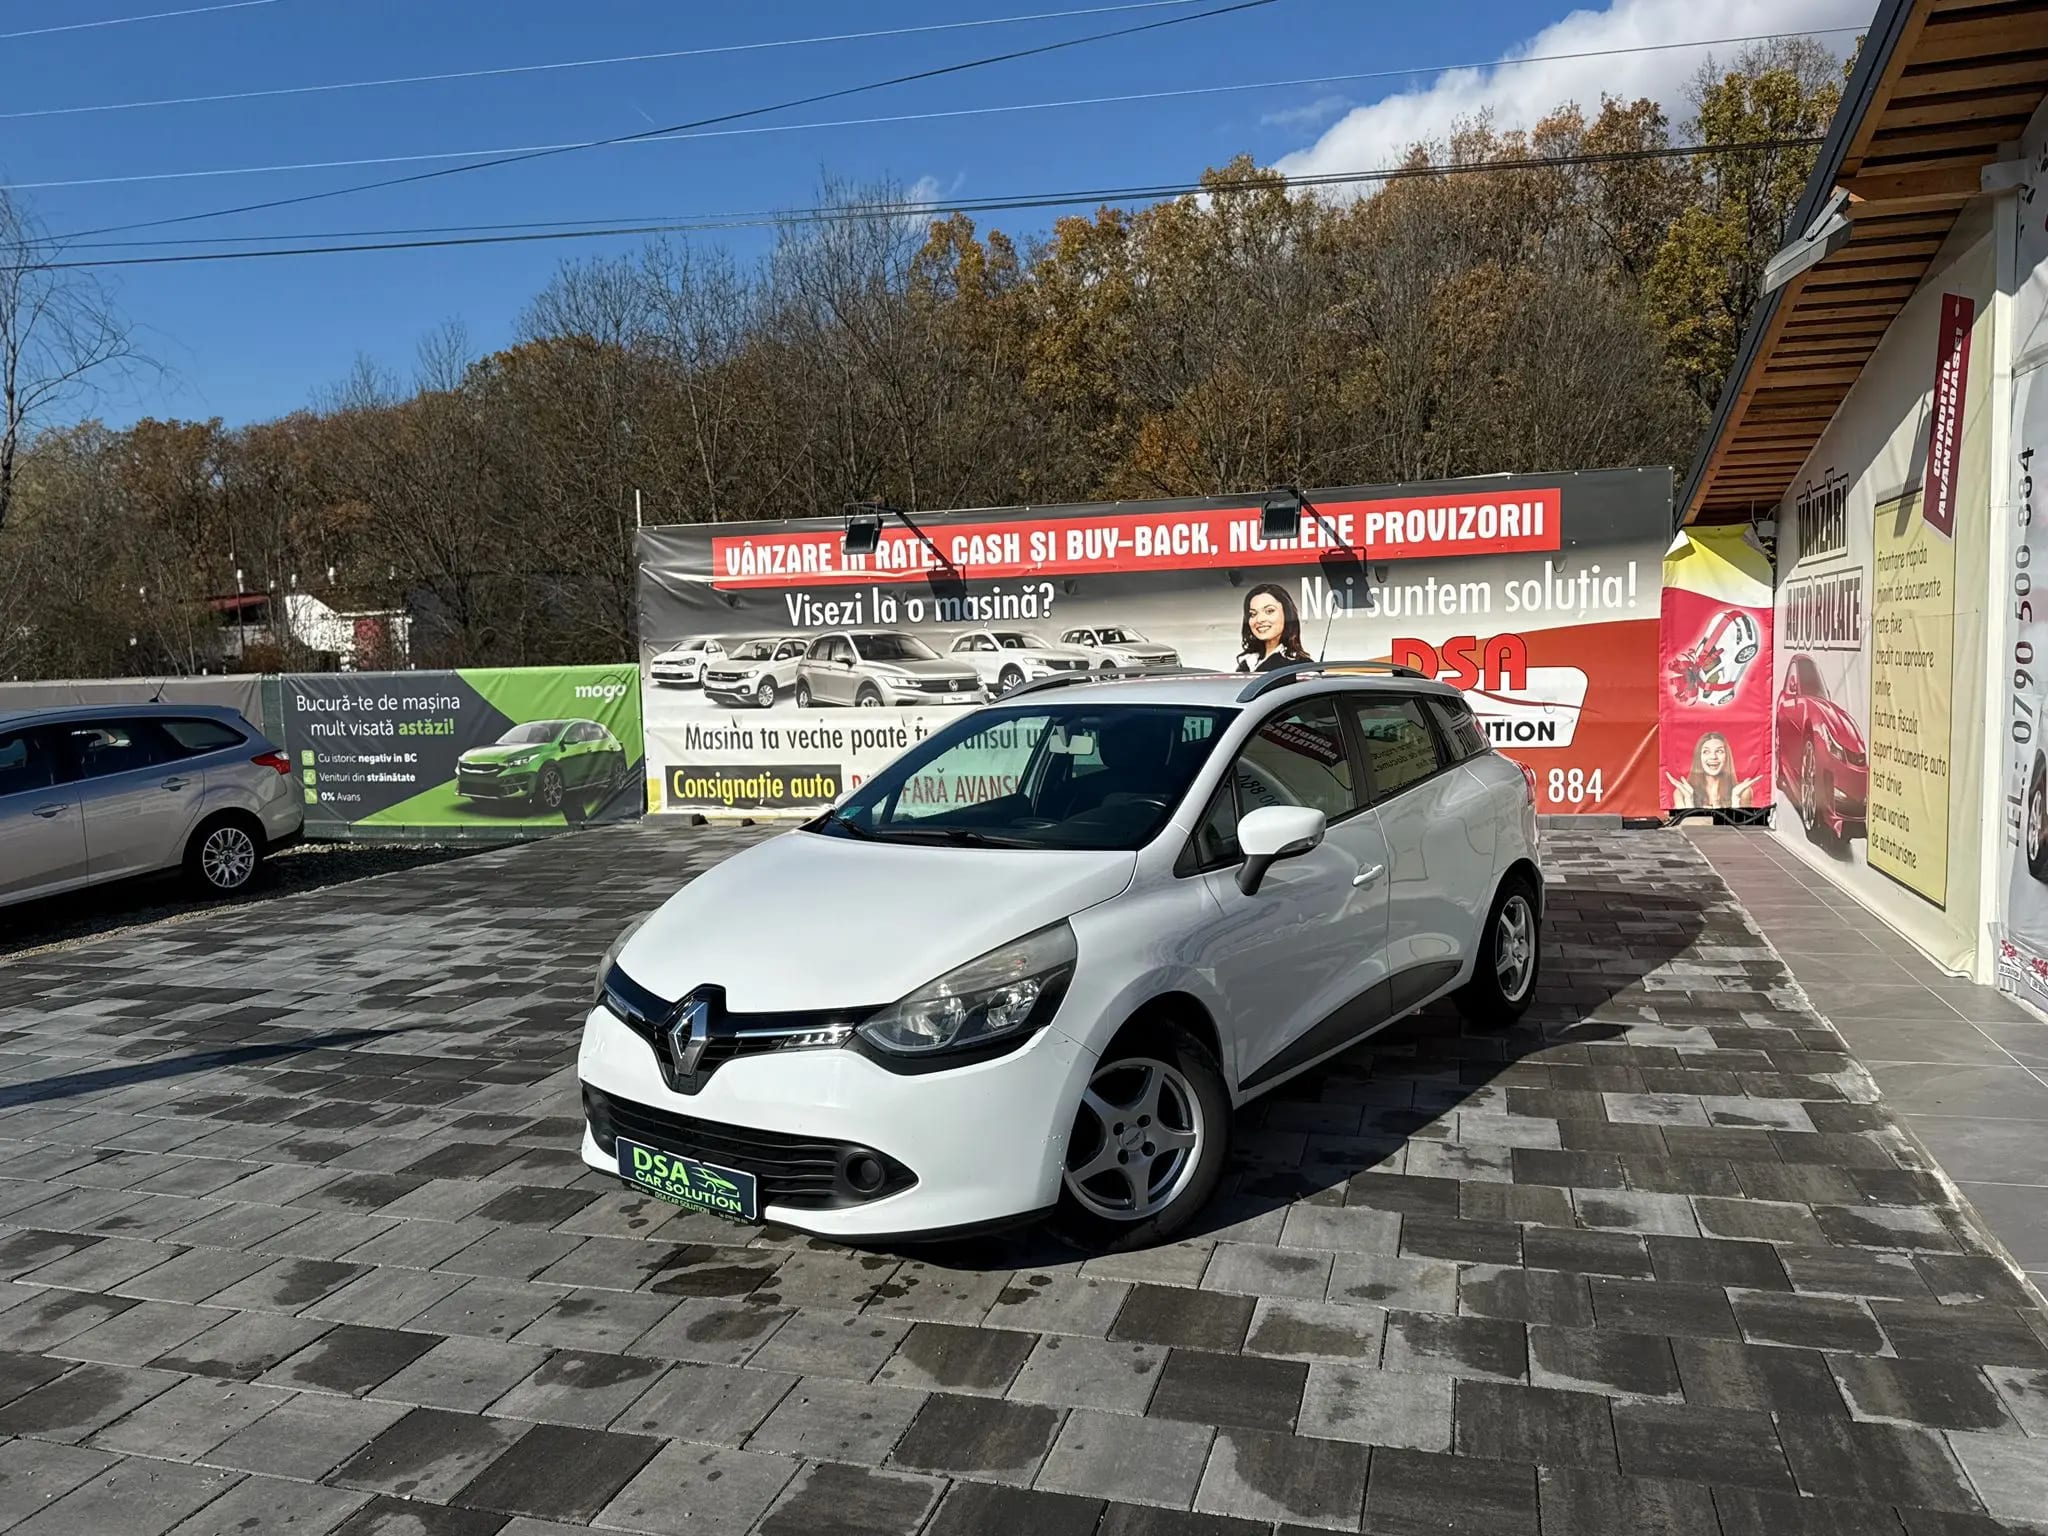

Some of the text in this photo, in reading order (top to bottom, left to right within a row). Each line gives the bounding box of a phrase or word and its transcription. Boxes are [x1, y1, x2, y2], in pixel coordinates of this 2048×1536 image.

[1933, 360, 1951, 478] CONDITII
[2016, 447, 2034, 527] 884
[1797, 477, 1847, 560] VÂNZĂRI
[725, 541, 833, 576] VÂNZARE
[952, 532, 1020, 565] CASH
[1067, 521, 1218, 560] BUY-BACK,
[1366, 502, 1545, 545] PROVIZORII
[1301, 561, 1637, 620] Noi suntem soluția!
[1895, 579, 1903, 601] de
[1904, 576, 1941, 601] documente
[2014, 545, 2033, 623] 500
[784, 583, 1055, 627] Visezi la o mașină?
[1786, 576, 1861, 642] AUTO RULATE
[1876, 612, 1903, 635] rate fixe
[1391, 633, 1527, 691] DSA
[1895, 650, 1902, 666] cu
[296, 693, 460, 714] Bucură-te de mașina
[575, 684, 627, 703] mogo
[2011, 640, 2034, 744] 0790
[311, 718, 454, 736] mult visată astăzi!
[760, 726, 780, 750] ta
[787, 718, 843, 749] veche
[851, 725, 908, 755] poate
[318, 753, 330, 763] Cu
[331, 753, 356, 763] istoric
[358, 753, 392, 765] negativ
[404, 753, 418, 763] BC
[319, 772, 416, 782] Venituri din străinătate
[1893, 742, 1928, 771] documente
[1930, 754, 1946, 776] auto
[321, 791, 361, 802] 0% Avans
[673, 769, 784, 805] Consignație
[790, 774, 836, 798] auto
[1548, 767, 1604, 803] 884
[1873, 768, 1902, 796] test drive
[1872, 802, 1886, 823] gama
[1872, 827, 1917, 869] de autoturisme
[633, 1146, 690, 1186] DSA
[635, 1170, 662, 1188] CAR
[665, 1181, 742, 1212] SOLUTION
